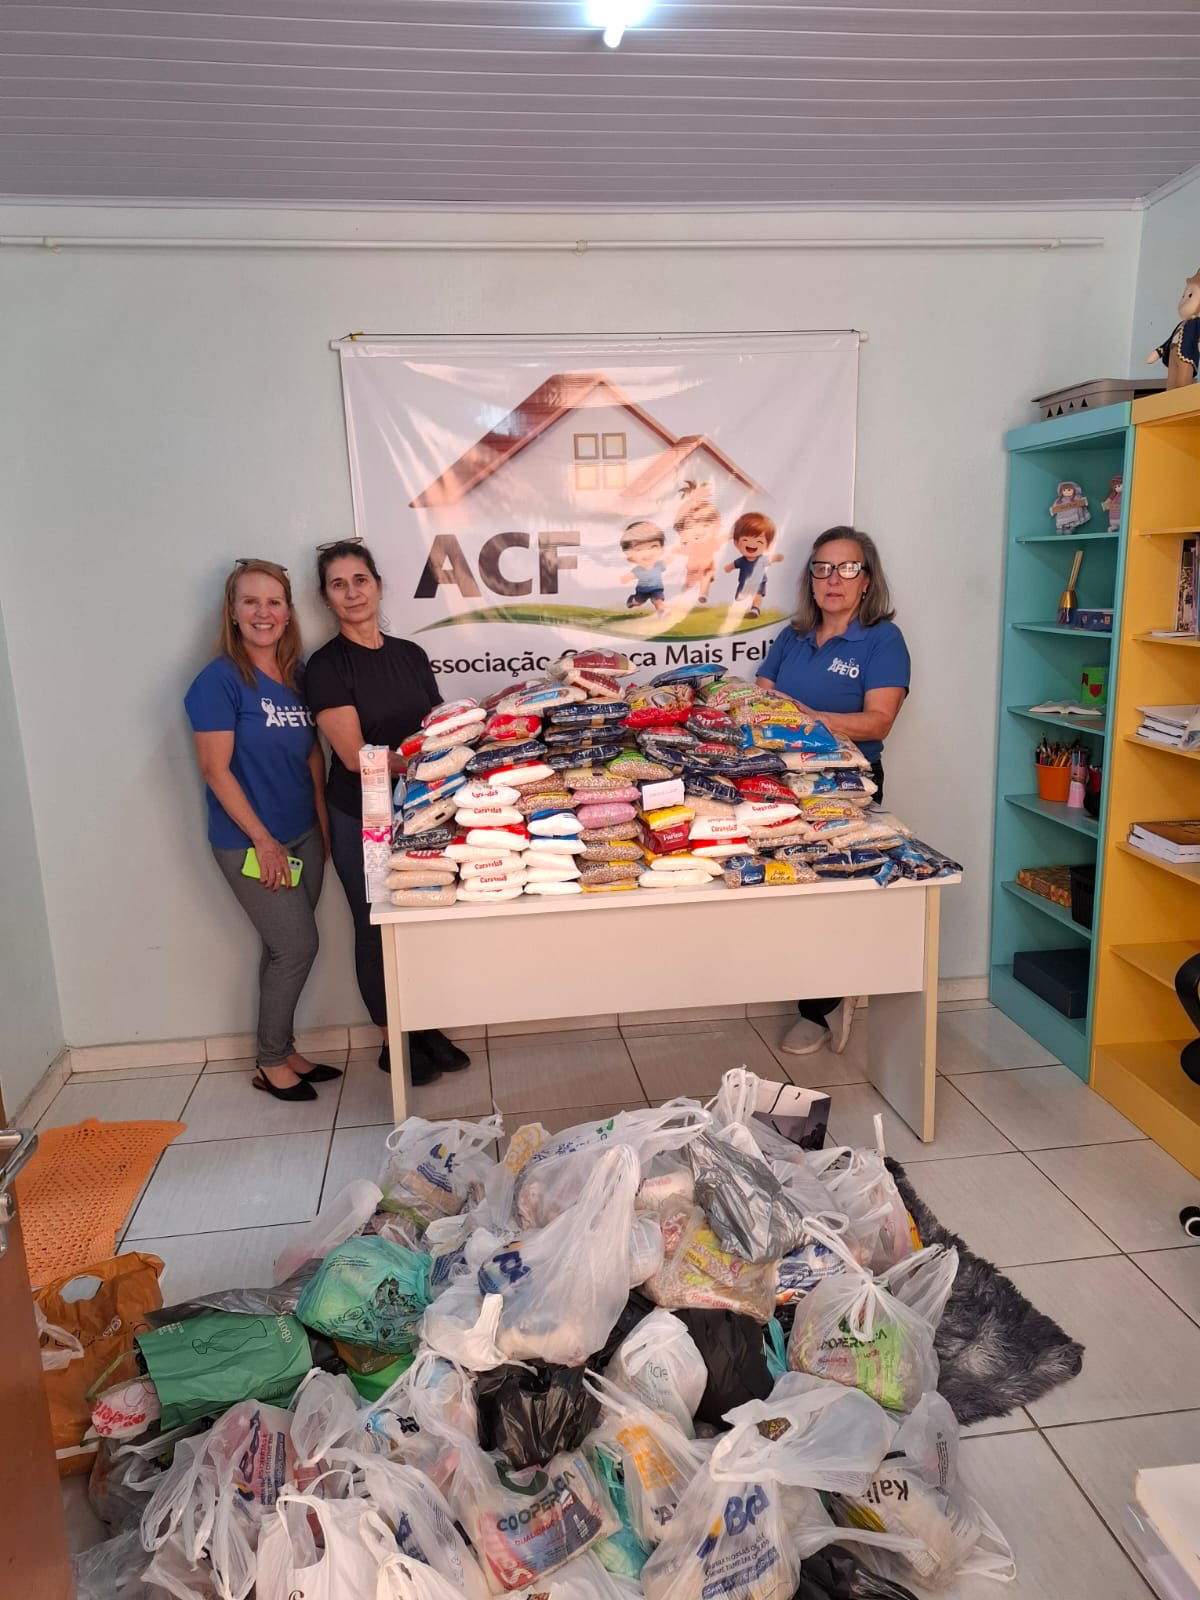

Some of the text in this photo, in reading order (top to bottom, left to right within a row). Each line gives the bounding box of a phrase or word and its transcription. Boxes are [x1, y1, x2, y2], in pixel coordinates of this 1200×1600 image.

[413, 531, 581, 599] ACF
[431, 651, 550, 677] ssociação
[665, 643, 723, 665] Mais
[732, 639, 774, 661] Fel
